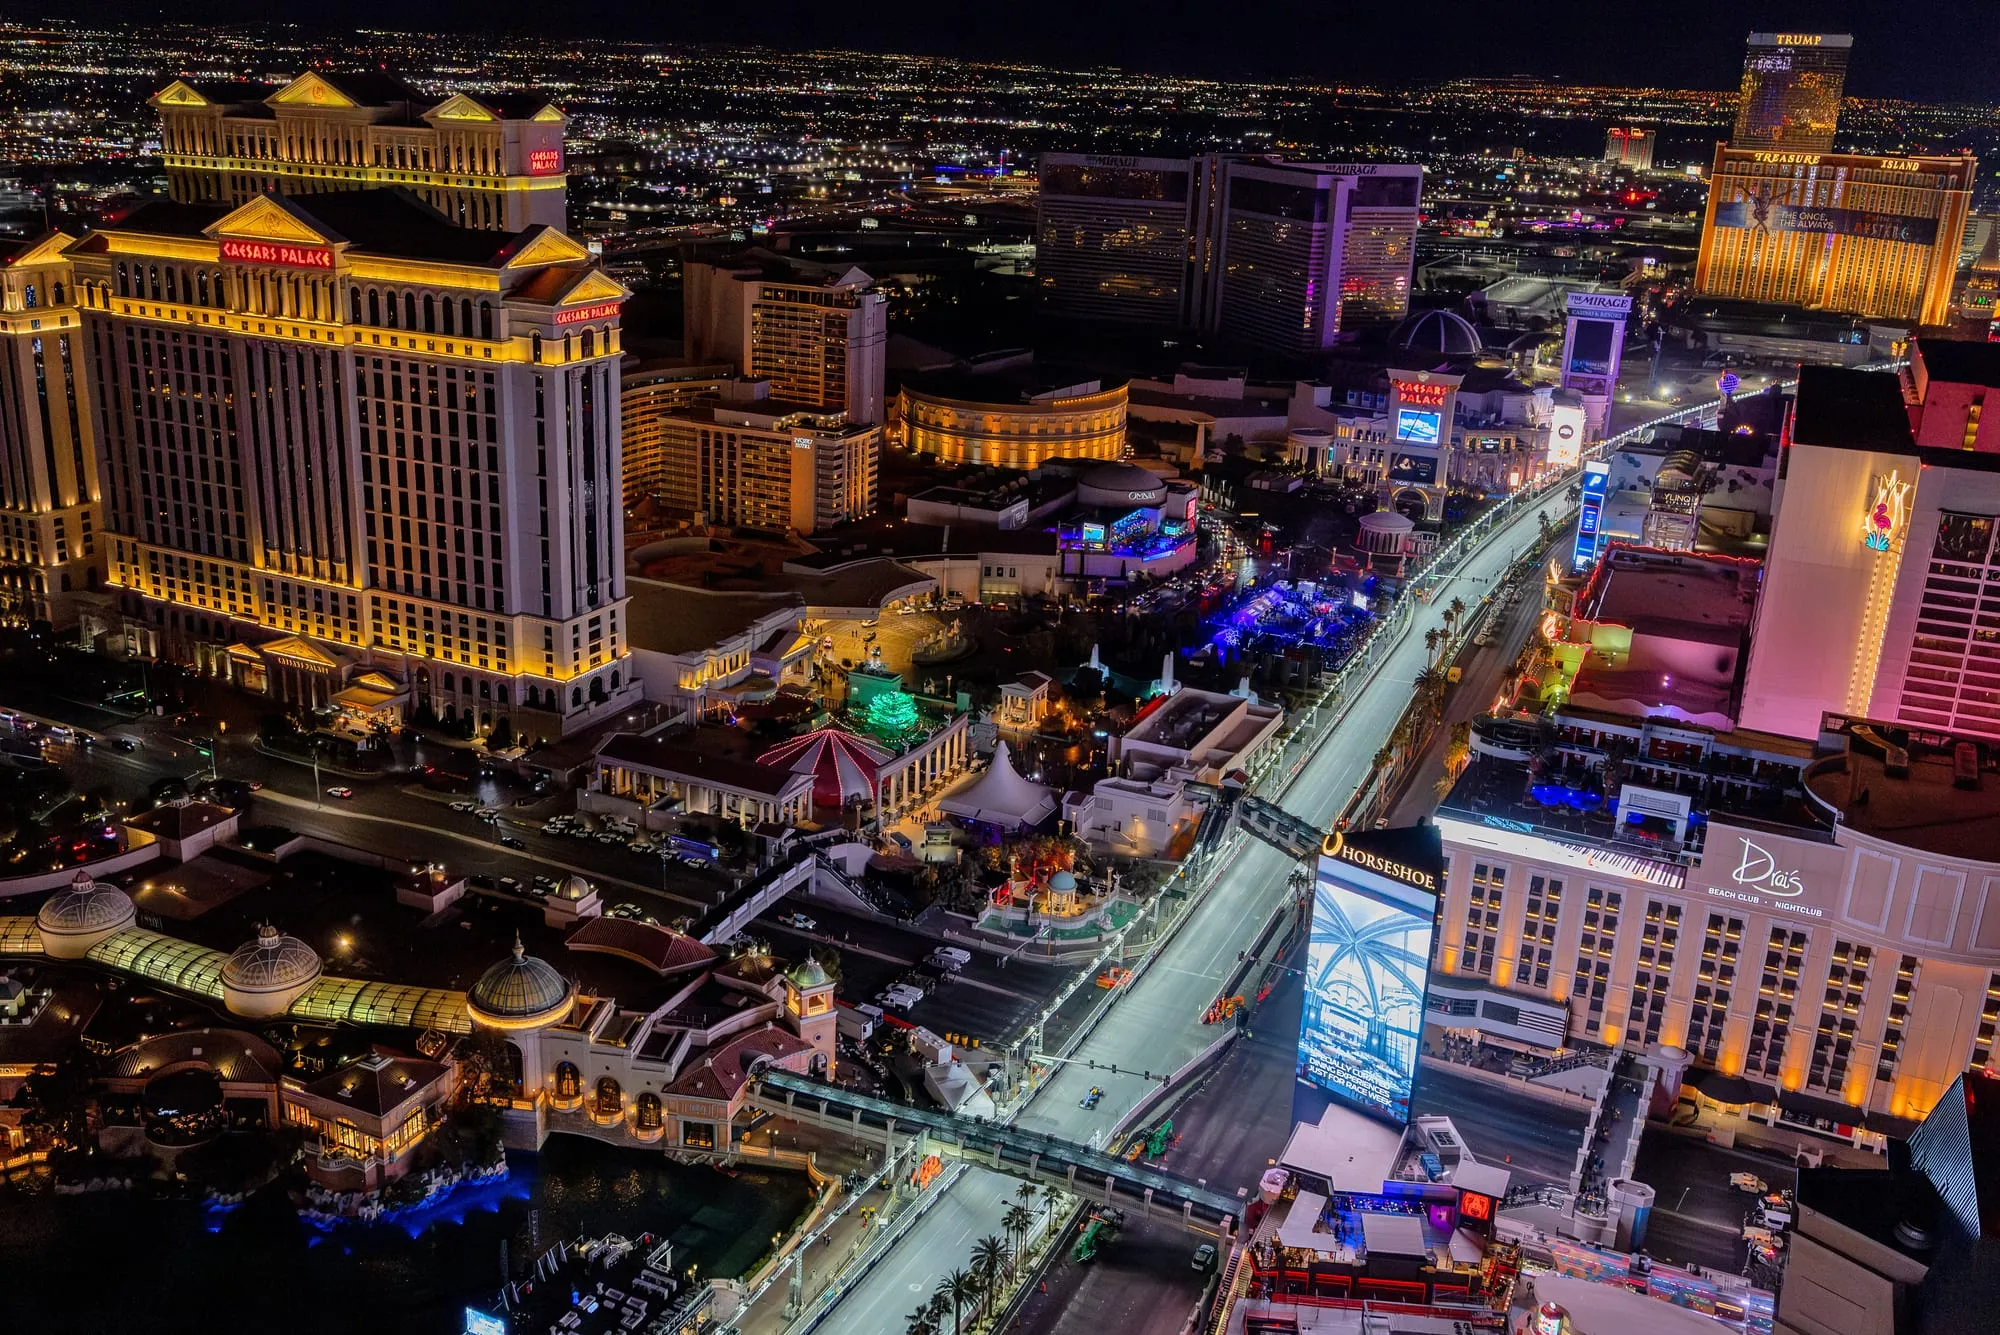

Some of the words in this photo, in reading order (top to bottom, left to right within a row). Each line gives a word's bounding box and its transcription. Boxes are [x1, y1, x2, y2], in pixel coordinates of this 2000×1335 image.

[1776, 34, 1822, 45] TRUMP
[530, 151, 559, 160] CAESARS
[1754, 152, 1821, 165] TREASURE
[1880, 159, 1920, 171] ISLAND
[532, 160, 557, 170] PALACE
[1335, 165, 1378, 175] MIRAGE
[1781, 211, 1798, 220] THE
[1780, 219, 1796, 228] THE
[223, 242, 277, 261] CAESARS
[281, 248, 330, 266] PALACE
[1574, 296, 1629, 308] MIRAGE
[556, 309, 589, 324] CAESARS
[591, 304, 618, 318] PALACE
[1398, 381, 1448, 396] CAESARS
[1399, 393, 1445, 406] PALACE
[1732, 836, 1804, 897] Drai's
[1707, 887, 1736, 900] BEACH
[1737, 892, 1760, 904] CLUB
[1774, 901, 1823, 917] NIGHTCLUB
[1309, 1057, 1336, 1074] DINING
[1336, 1070, 1391, 1099] EXPERIENCES
[1308, 1065, 1328, 1078] JUST
[1328, 1073, 1346, 1086] FOR
[1345, 1081, 1368, 1097] RACE
[1367, 1091, 1393, 1108] WEEK
